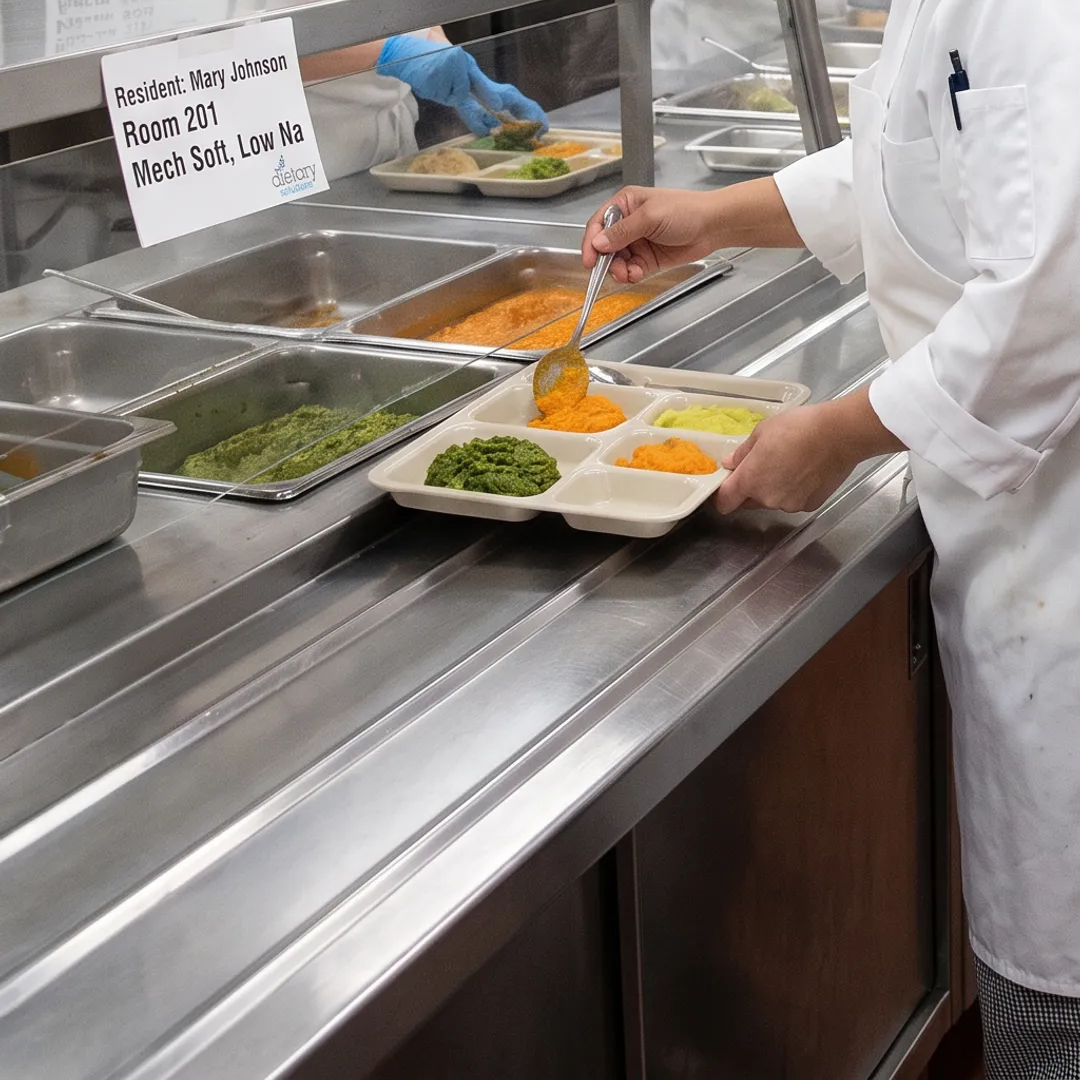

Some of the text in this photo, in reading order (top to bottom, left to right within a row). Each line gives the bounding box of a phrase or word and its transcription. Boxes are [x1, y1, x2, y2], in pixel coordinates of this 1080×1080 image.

[114, 54, 288, 109] Resident: Mary Johnson
[122, 100, 219, 148] Room 201
[132, 120, 304, 188] Mech Soft, Low Na
[271, 164, 316, 188] dietary
